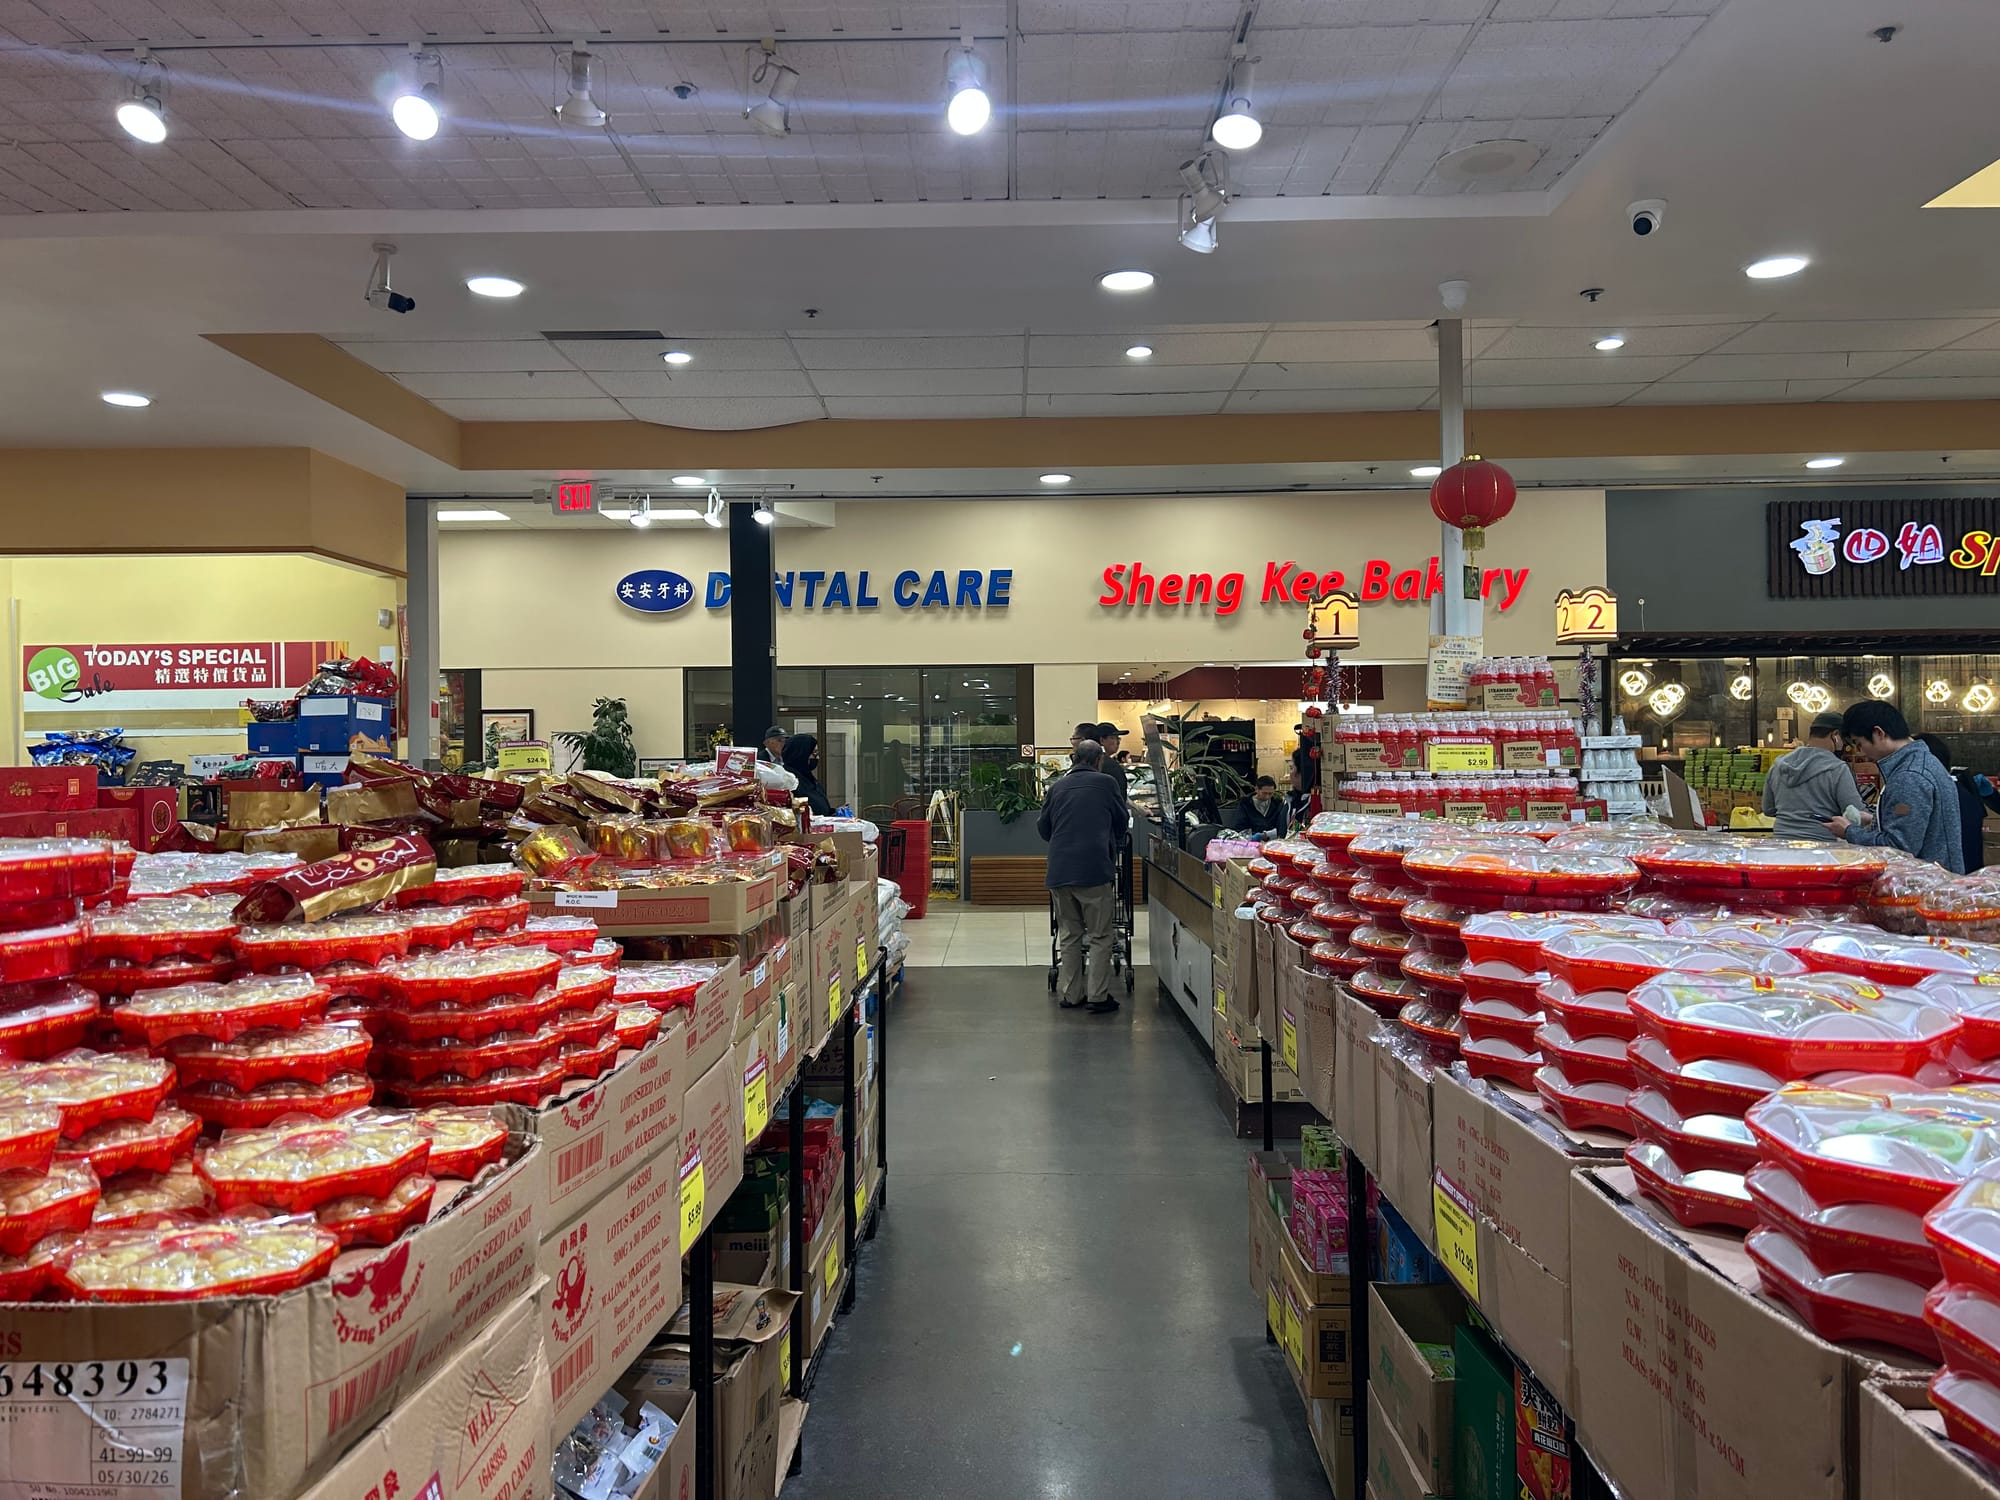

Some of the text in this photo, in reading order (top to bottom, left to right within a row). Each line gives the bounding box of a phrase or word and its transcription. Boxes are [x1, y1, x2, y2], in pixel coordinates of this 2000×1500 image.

[560, 484, 592, 510] EXIT
[620, 581, 690, 601] 安安牙科
[705, 570, 1013, 608] DNTAL CARE
[1099, 556, 1530, 616] Sheng Kee Bakry
[1332, 609, 1342, 635] 1
[1561, 607, 1570, 632] 2
[1587, 604, 1604, 629] 2
[29, 657, 78, 692] BIG
[84, 649, 267, 666] TODAY'S SPECIAL
[57, 673, 115, 703] Sale
[155, 667, 267, 684] 精選特價貨品
[482, 1191, 513, 1230] 1648393
[607, 1213, 629, 1244] LOTUS
[646, 1180, 668, 1209] CANDY
[640, 1211, 663, 1241] BOXES
[449, 1204, 533, 1293] LOTUS SEED CANDY
[729, 1238, 767, 1252] meiji
[1453, 1241, 1475, 1276] $12.99
[601, 1275, 628, 1309] WALONG
[1683, 1306, 1717, 1351] BOXES
[1683, 1337, 1704, 1371] KGS
[1685, 1370, 1706, 1406] KGS
[104, 1407, 181, 1421] TO: 2784271
[467, 1399, 498, 1448] WAL
[99, 1448, 173, 1463] 41-99-99
[477, 1442, 508, 1494] 1648393
[511, 1441, 537, 1491] CANDY
[97, 1470, 169, 1484] 05/30/26
